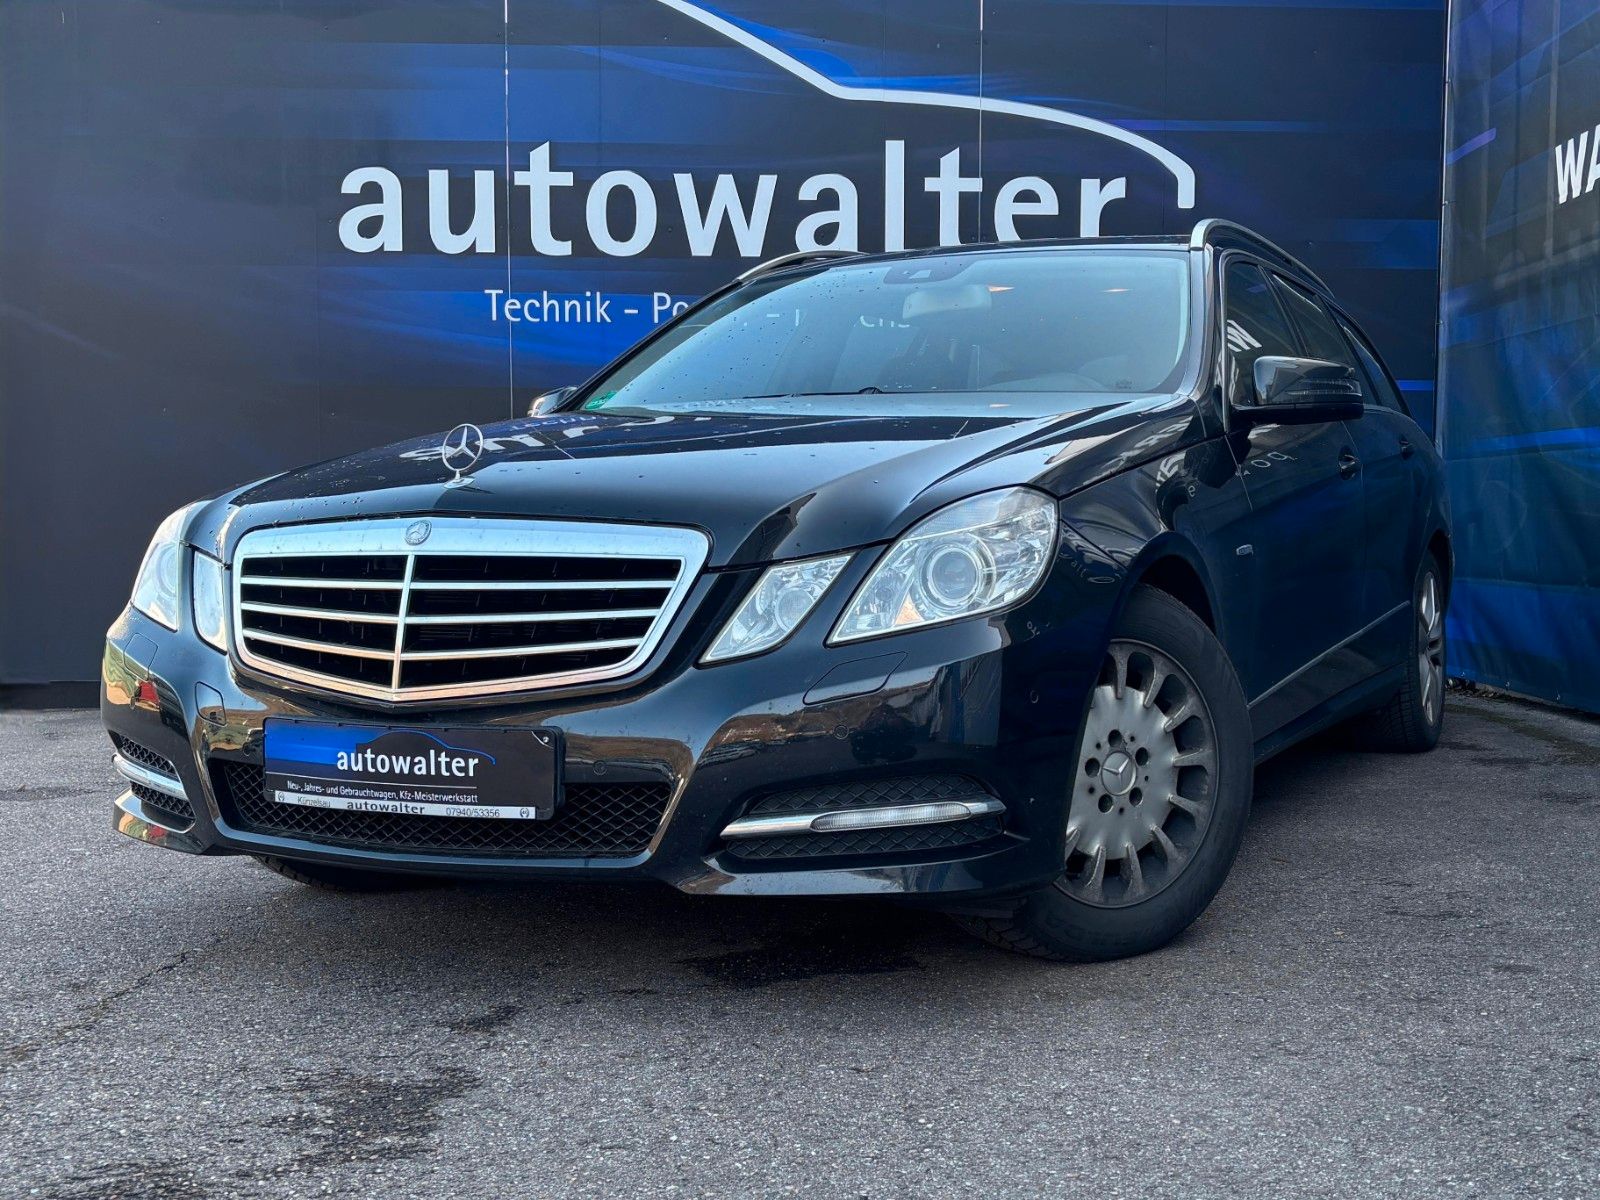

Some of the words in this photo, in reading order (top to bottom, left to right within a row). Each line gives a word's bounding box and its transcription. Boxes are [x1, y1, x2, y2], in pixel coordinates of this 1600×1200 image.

[338, 139, 1126, 257] autowalter
[484, 289, 612, 323] Technik
[336, 747, 479, 777] autowalter
[287, 780, 303, 792] Neu-,
[304, 782, 325, 793] Jahres-
[326, 785, 339, 795] und
[340, 785, 399, 801] Gebrauchtwagen,
[399, 790, 479, 803] Kfz-Meisterwerkstatt
[347, 800, 426, 814] autowalter
[445, 806, 501, 818] 07940/53356
